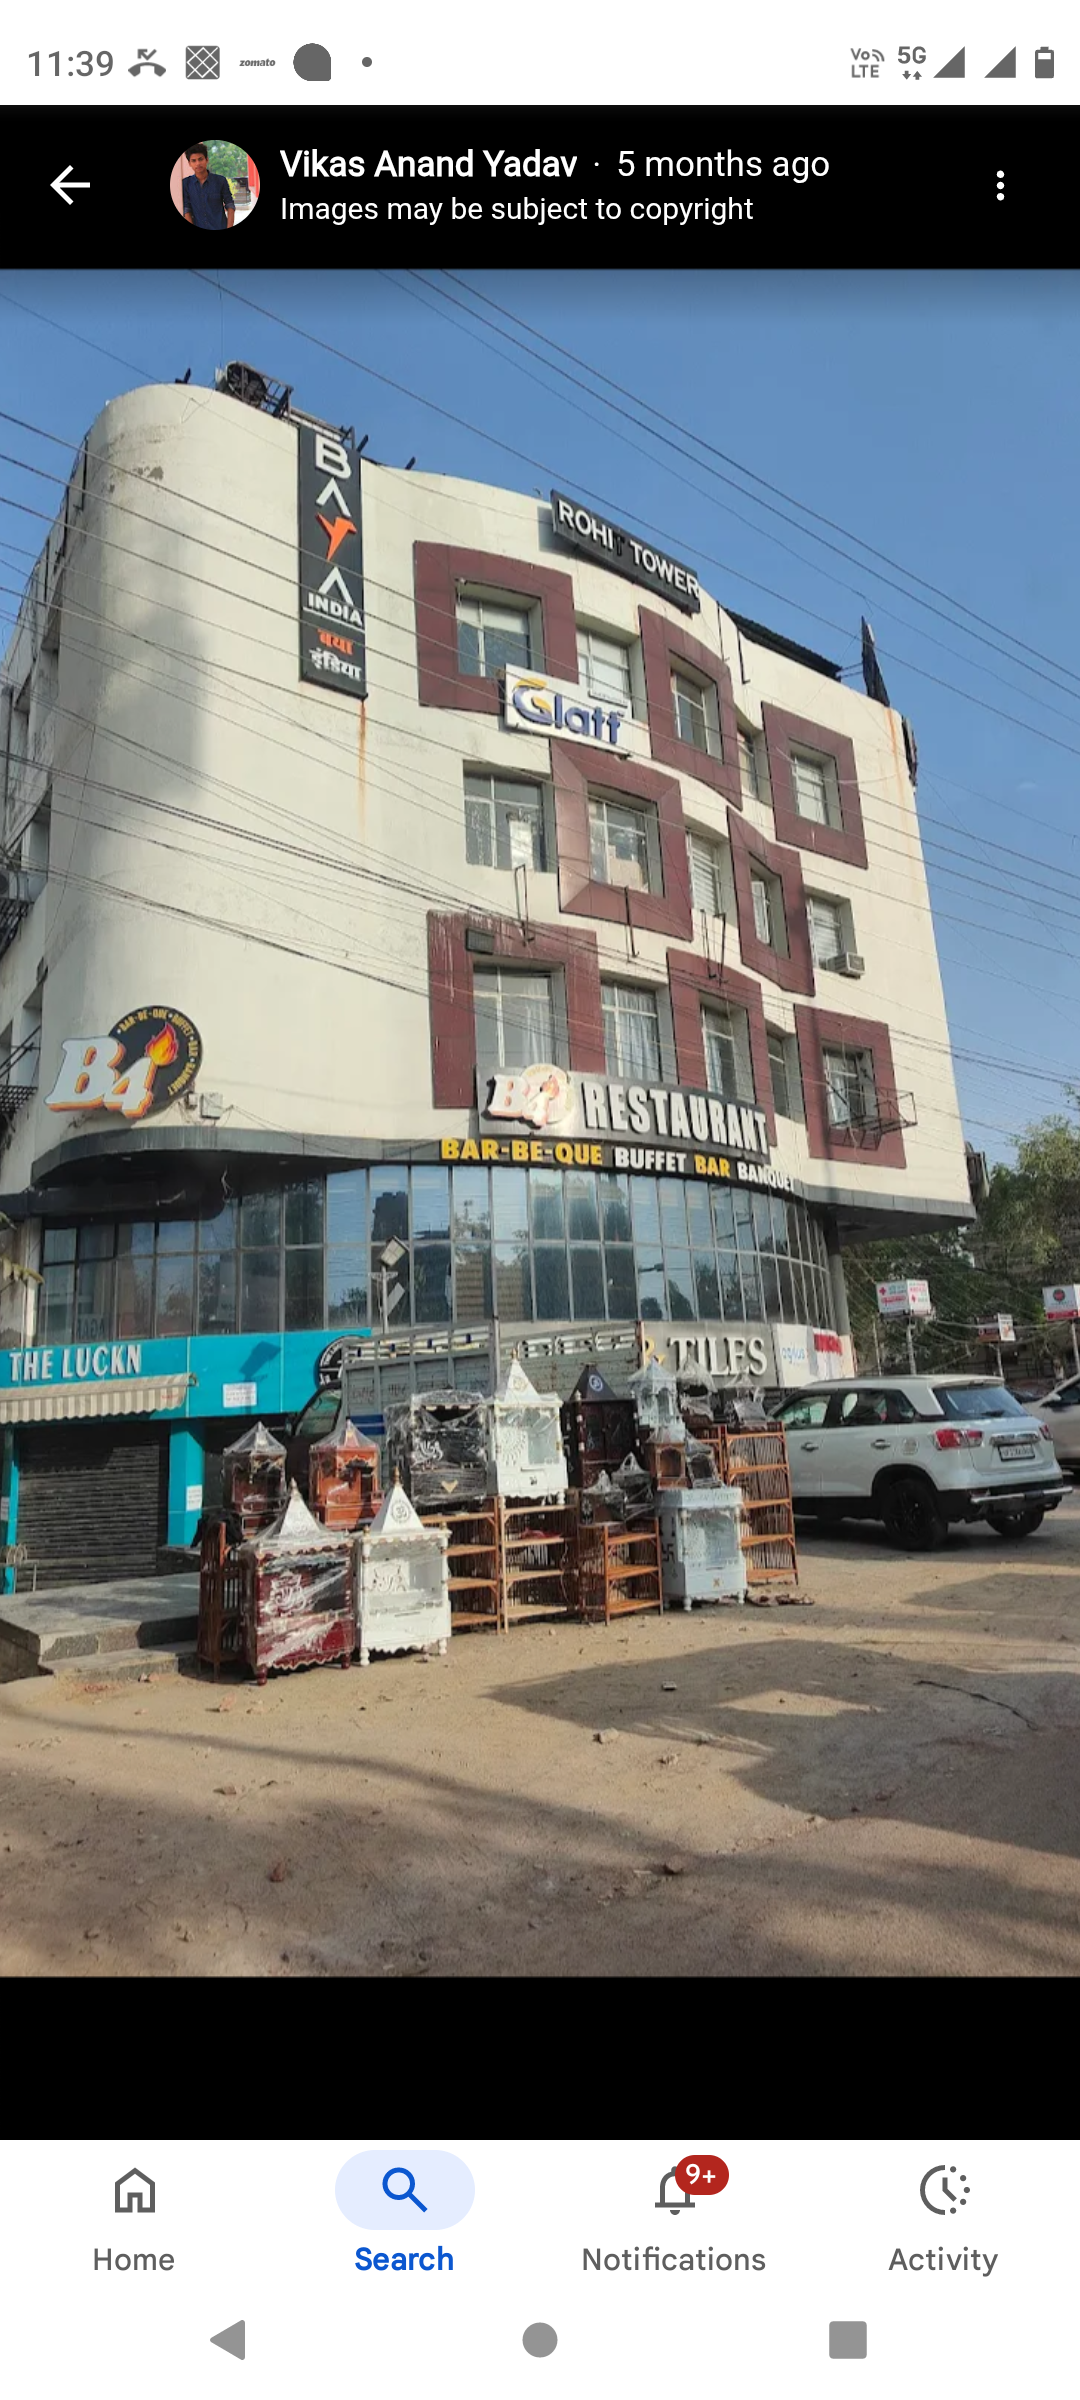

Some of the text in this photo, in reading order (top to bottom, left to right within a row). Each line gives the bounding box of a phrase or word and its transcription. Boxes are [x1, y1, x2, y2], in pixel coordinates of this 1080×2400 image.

[629, 539, 701, 598] TOWER
[308, 592, 363, 628] INDIA
[308, 646, 362, 681] इंडिया
[512, 677, 623, 745] Glatt
[44, 1035, 158, 1119] B4
[581, 1081, 769, 1155] RESTAURANT
[441, 1138, 794, 1192] BAR-BE-QUE BUFFET BAR BANQUET
[9, 1343, 143, 1382] THE LUCKN
[669, 1335, 768, 1377] TILES
